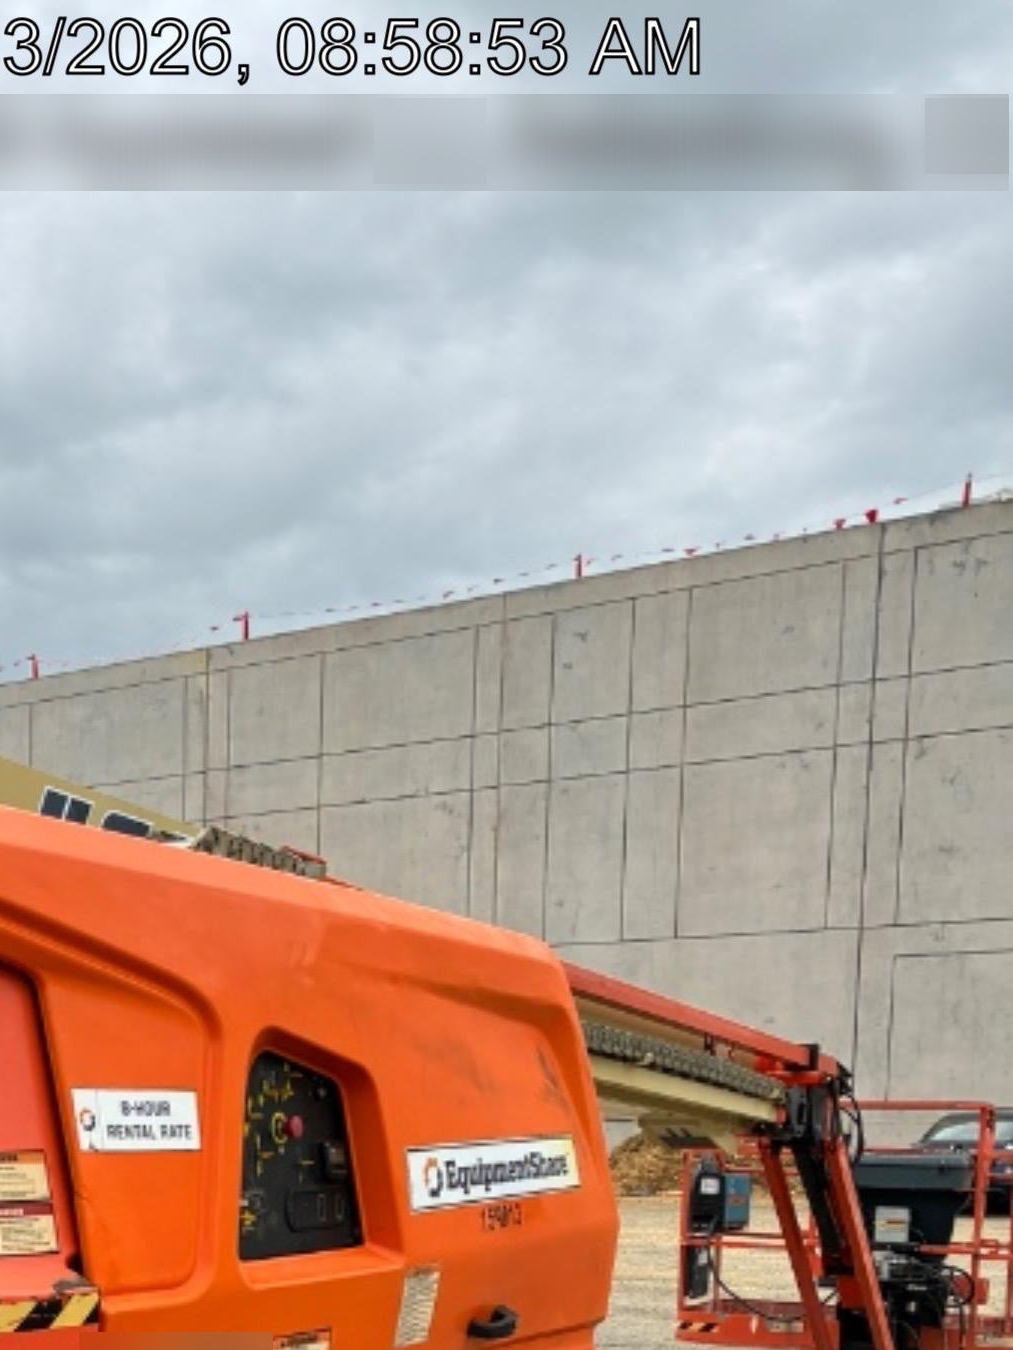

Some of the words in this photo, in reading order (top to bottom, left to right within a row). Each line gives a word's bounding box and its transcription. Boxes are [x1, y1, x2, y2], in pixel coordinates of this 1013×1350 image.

[106, 1124, 156, 1140] RENTAL
[160, 1124, 192, 1140] RATE
[444, 1151, 570, 1195] EquipmentShare
